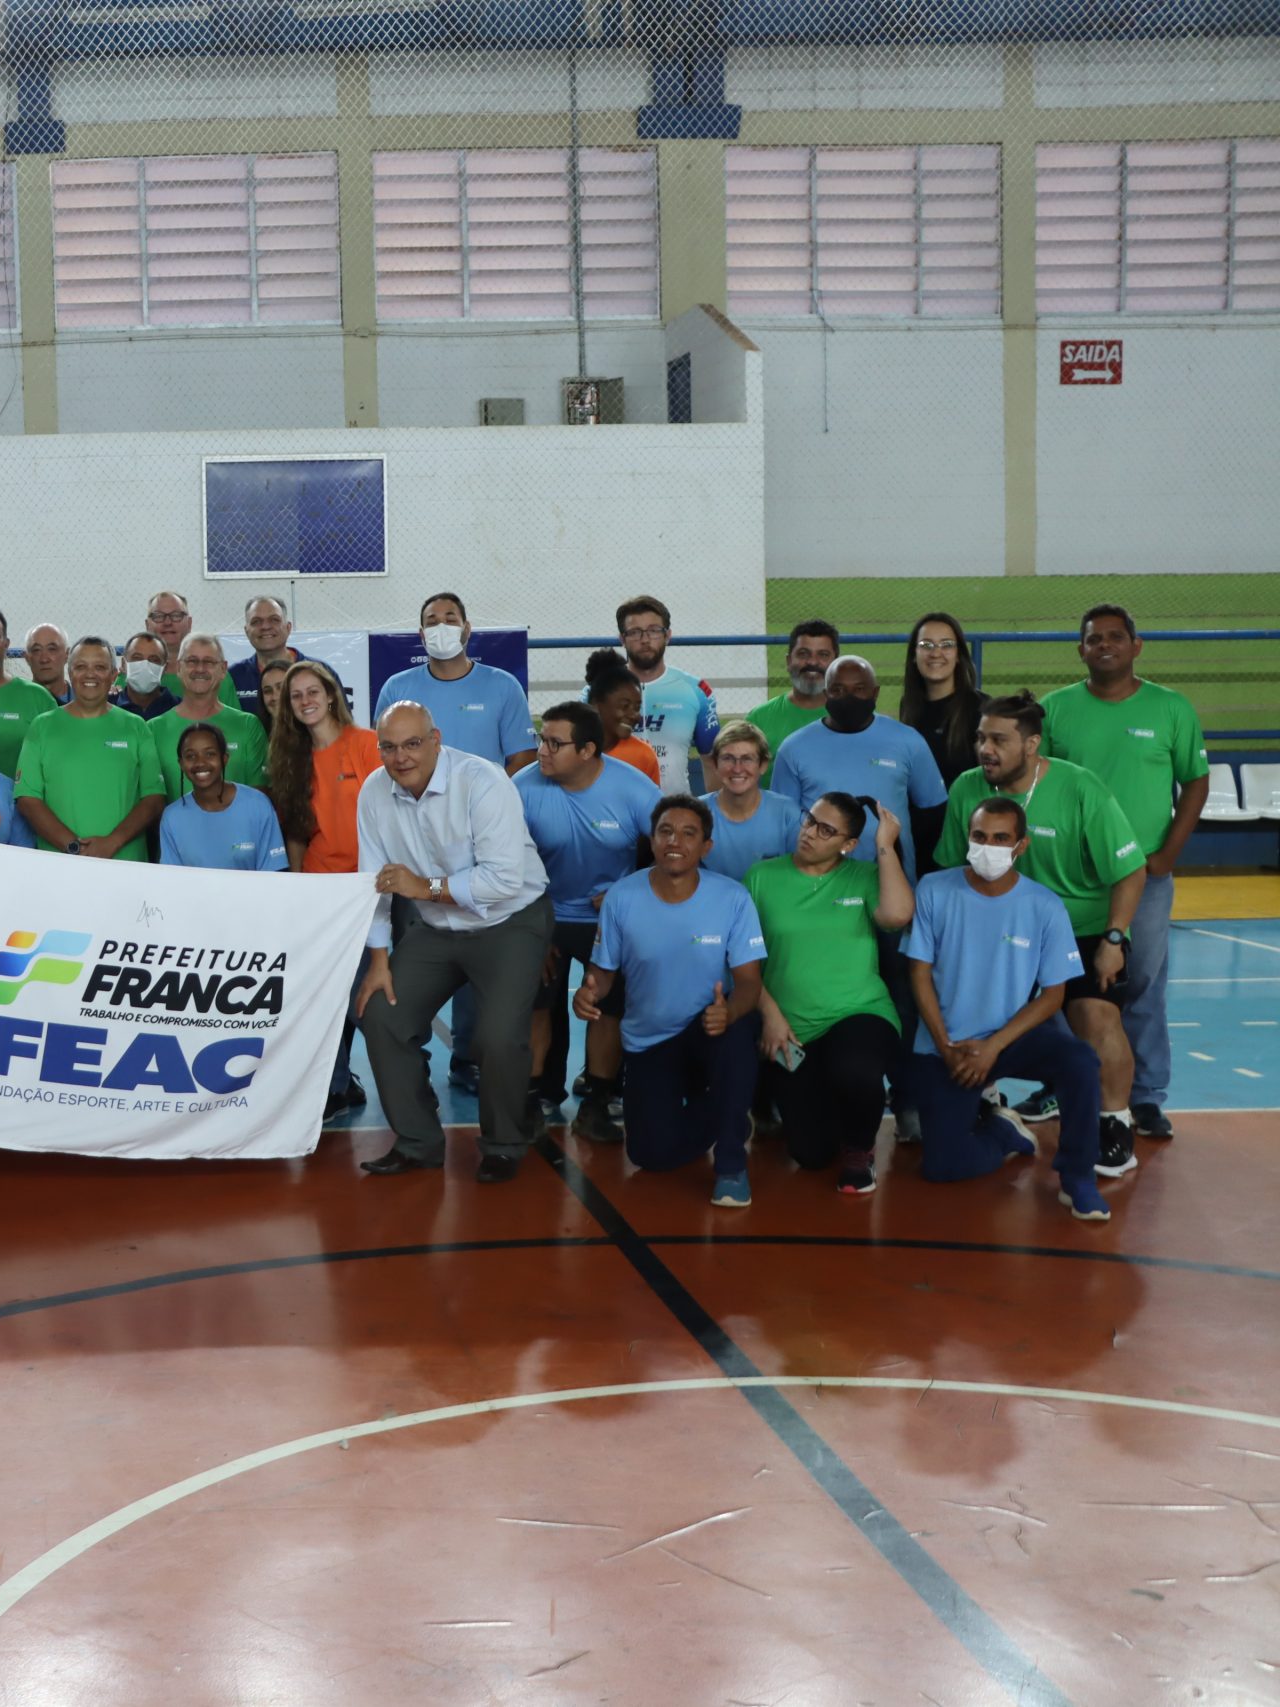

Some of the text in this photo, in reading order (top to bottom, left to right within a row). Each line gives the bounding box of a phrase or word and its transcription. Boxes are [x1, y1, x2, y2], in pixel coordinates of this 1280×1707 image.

[1063, 344, 1120, 363] SAIDA
[98, 940, 287, 973] PREFEITURA
[81, 964, 284, 1015] FRANCA
[79, 1007, 280, 1030] TRABALHO E COMPROMISSO COM VOCÊ
[58, 1092, 130, 1112] ESPORTE,
[132, 1099, 171, 1112] ARTE
[175, 1101, 183, 1113] E
[188, 1095, 249, 1113] CULTURA
